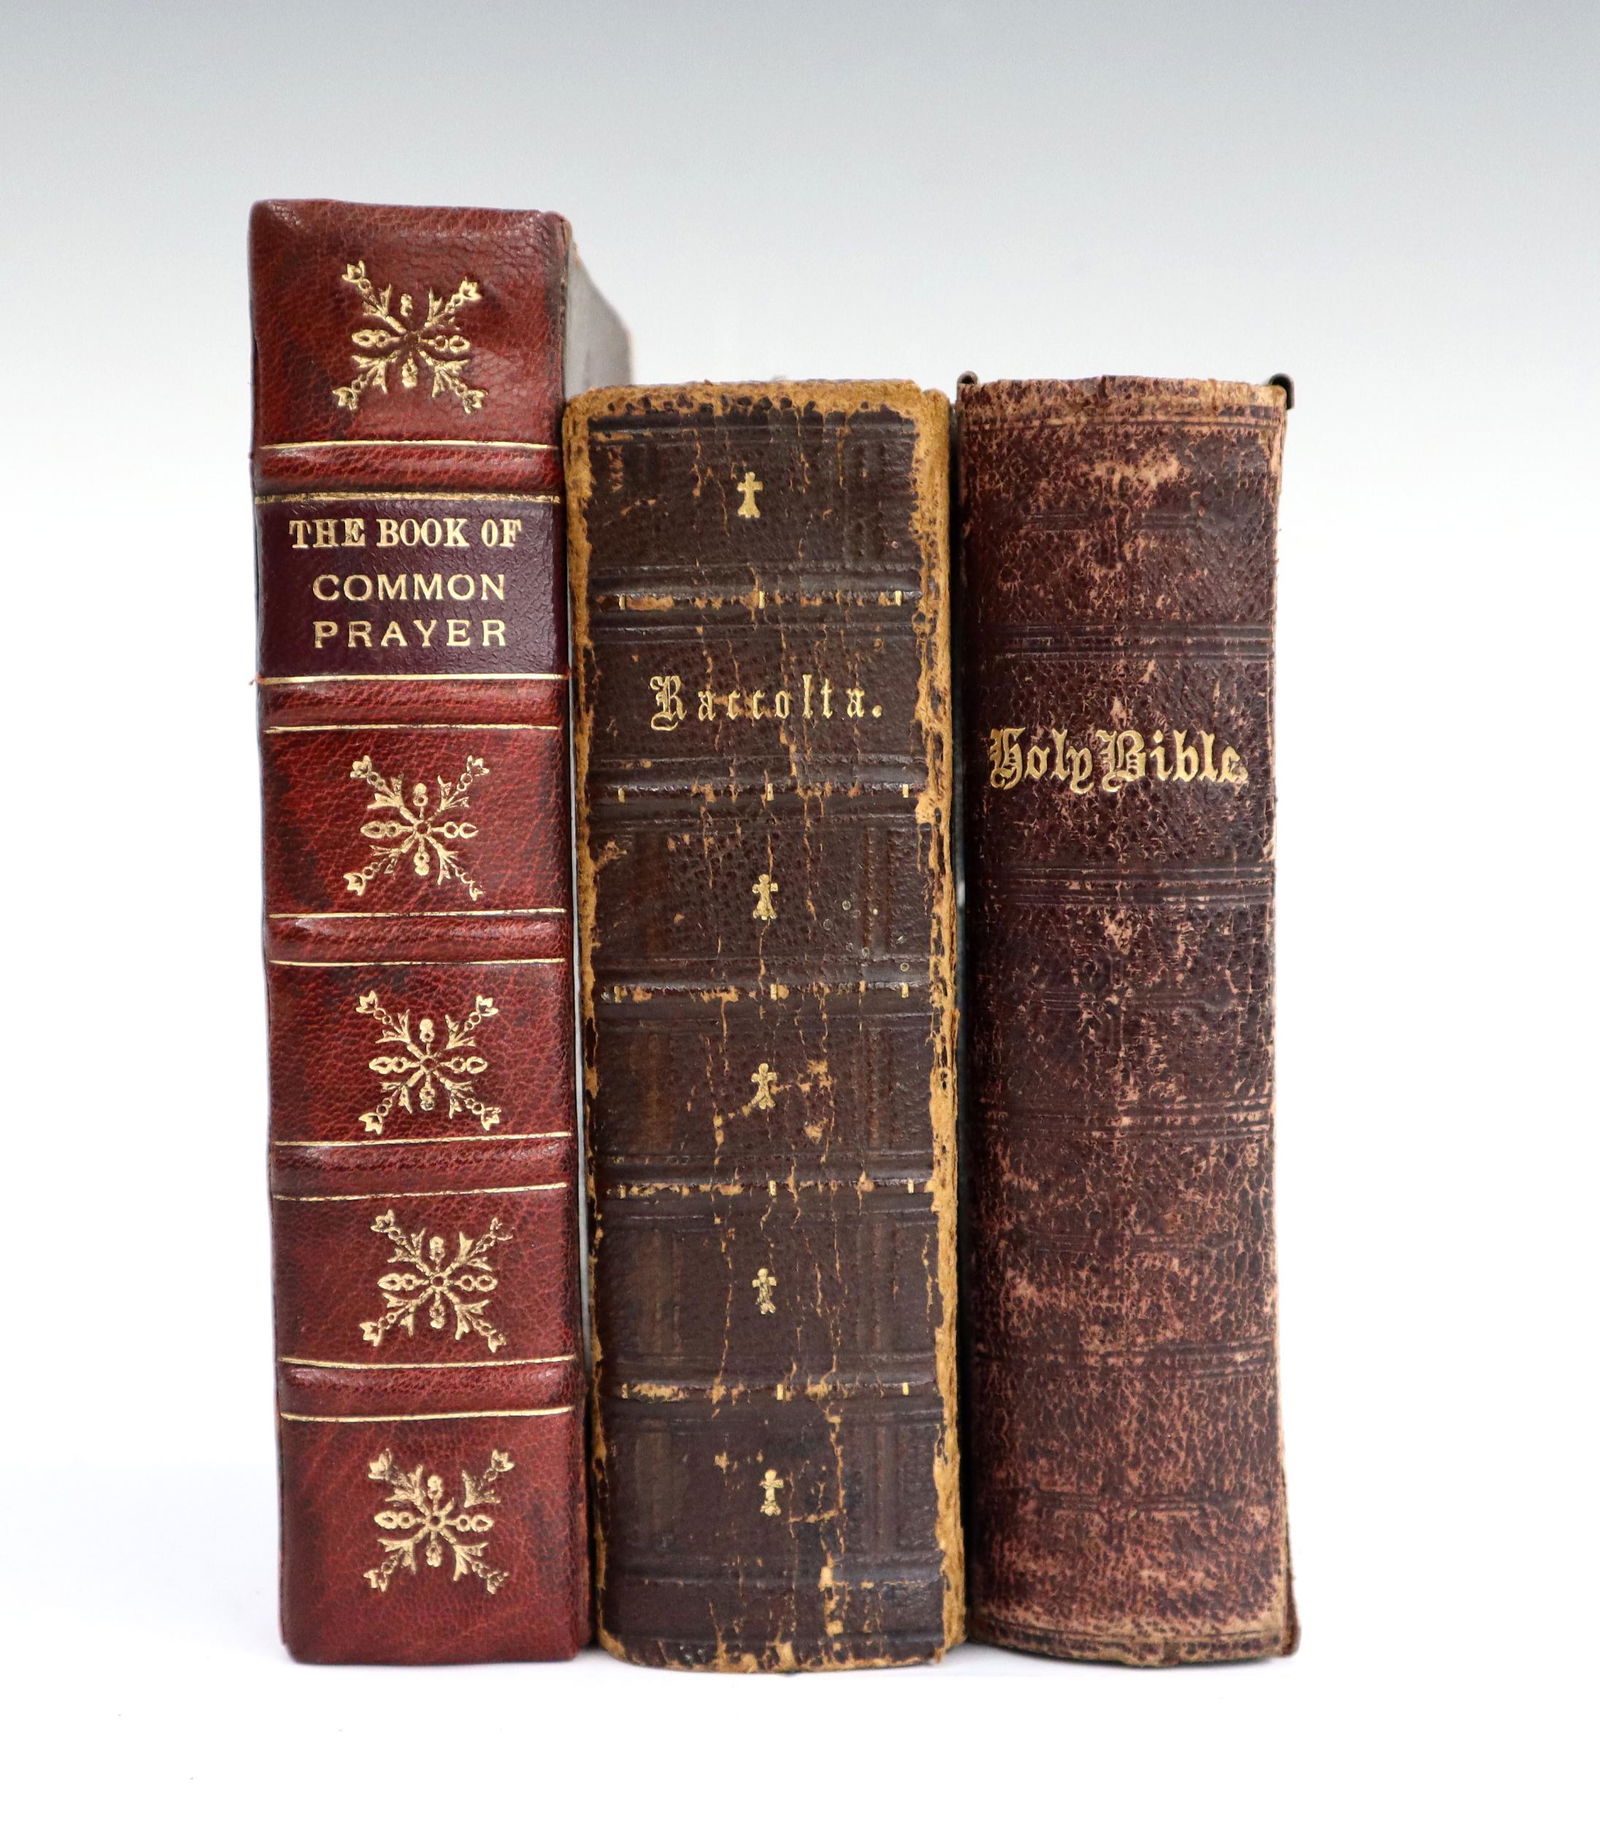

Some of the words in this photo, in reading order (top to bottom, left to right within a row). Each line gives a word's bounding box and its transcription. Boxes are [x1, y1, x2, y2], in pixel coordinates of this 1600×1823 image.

[289, 518, 366, 549] THE
[376, 518, 470, 548] BOOK
[481, 518, 522, 548] OF
[312, 574, 506, 601] COMMON
[313, 619, 507, 649] PRAYER
[649, 673, 884, 732] Raccolta.
[989, 727, 1095, 795] Holy
